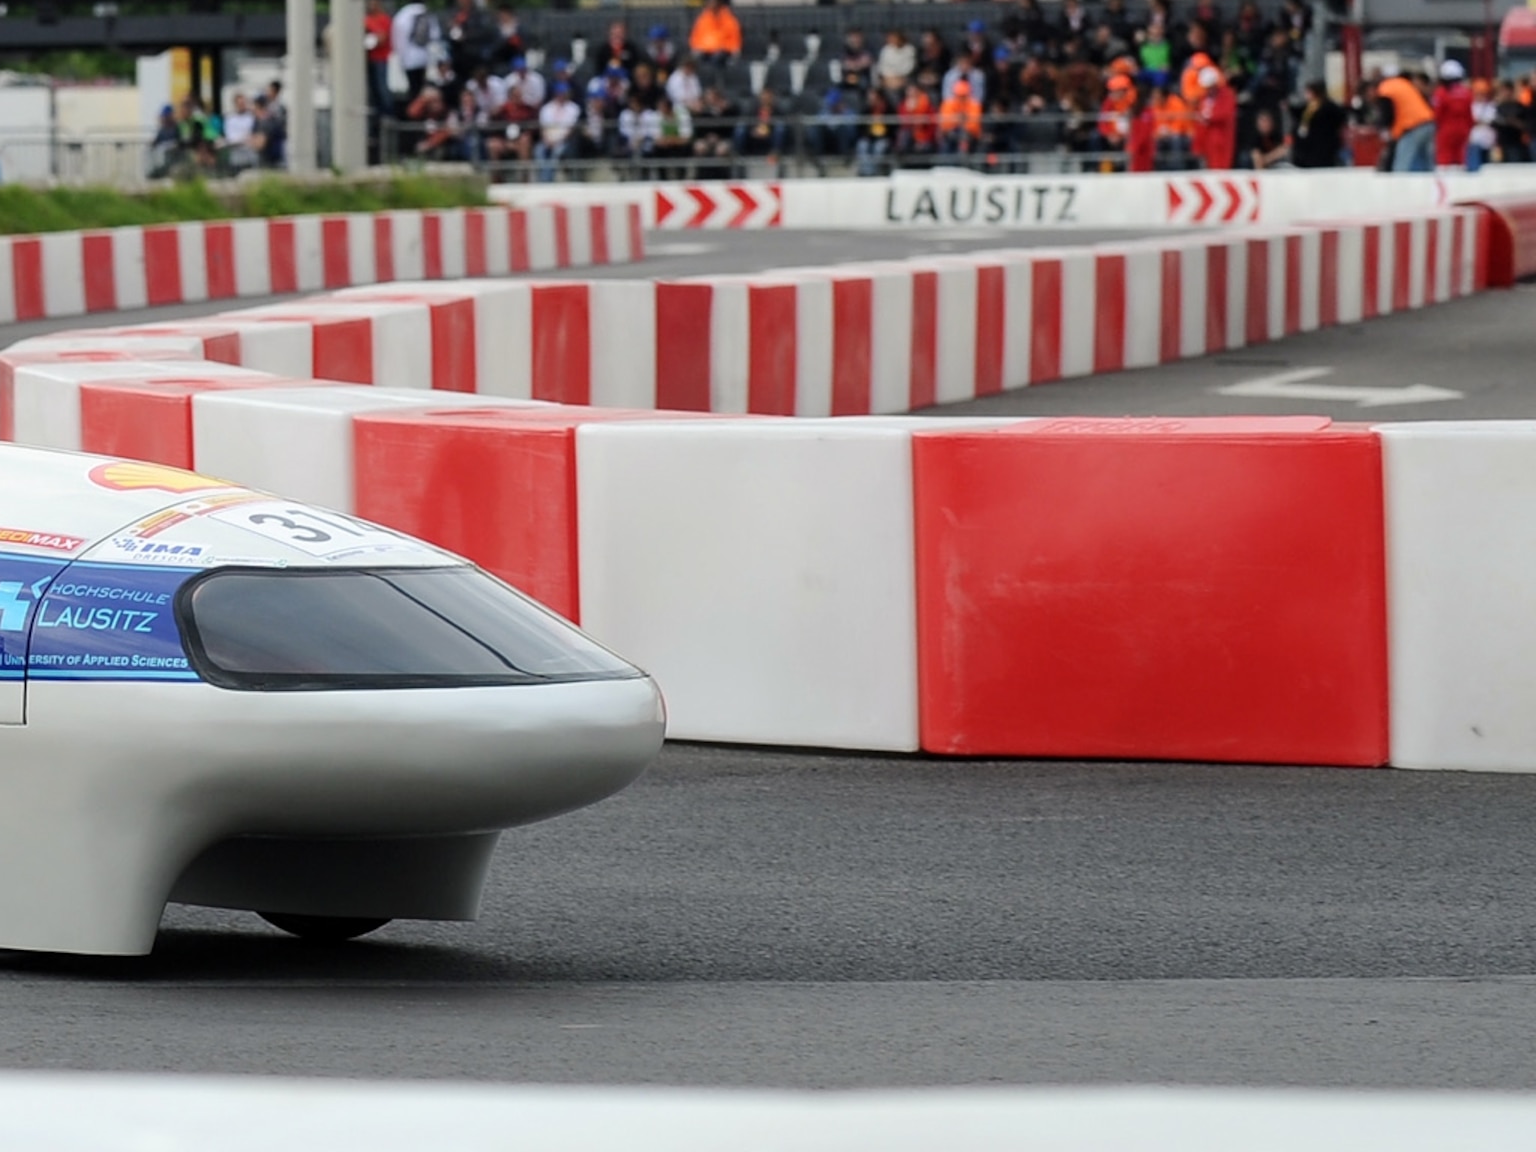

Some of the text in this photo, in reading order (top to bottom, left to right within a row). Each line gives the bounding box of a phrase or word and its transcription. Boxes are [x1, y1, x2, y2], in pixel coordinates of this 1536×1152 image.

[886, 186, 1078, 224] LAUSITZ
[50, 584, 170, 605] HOCHSCHULE
[37, 599, 158, 632] LAUSITZ
